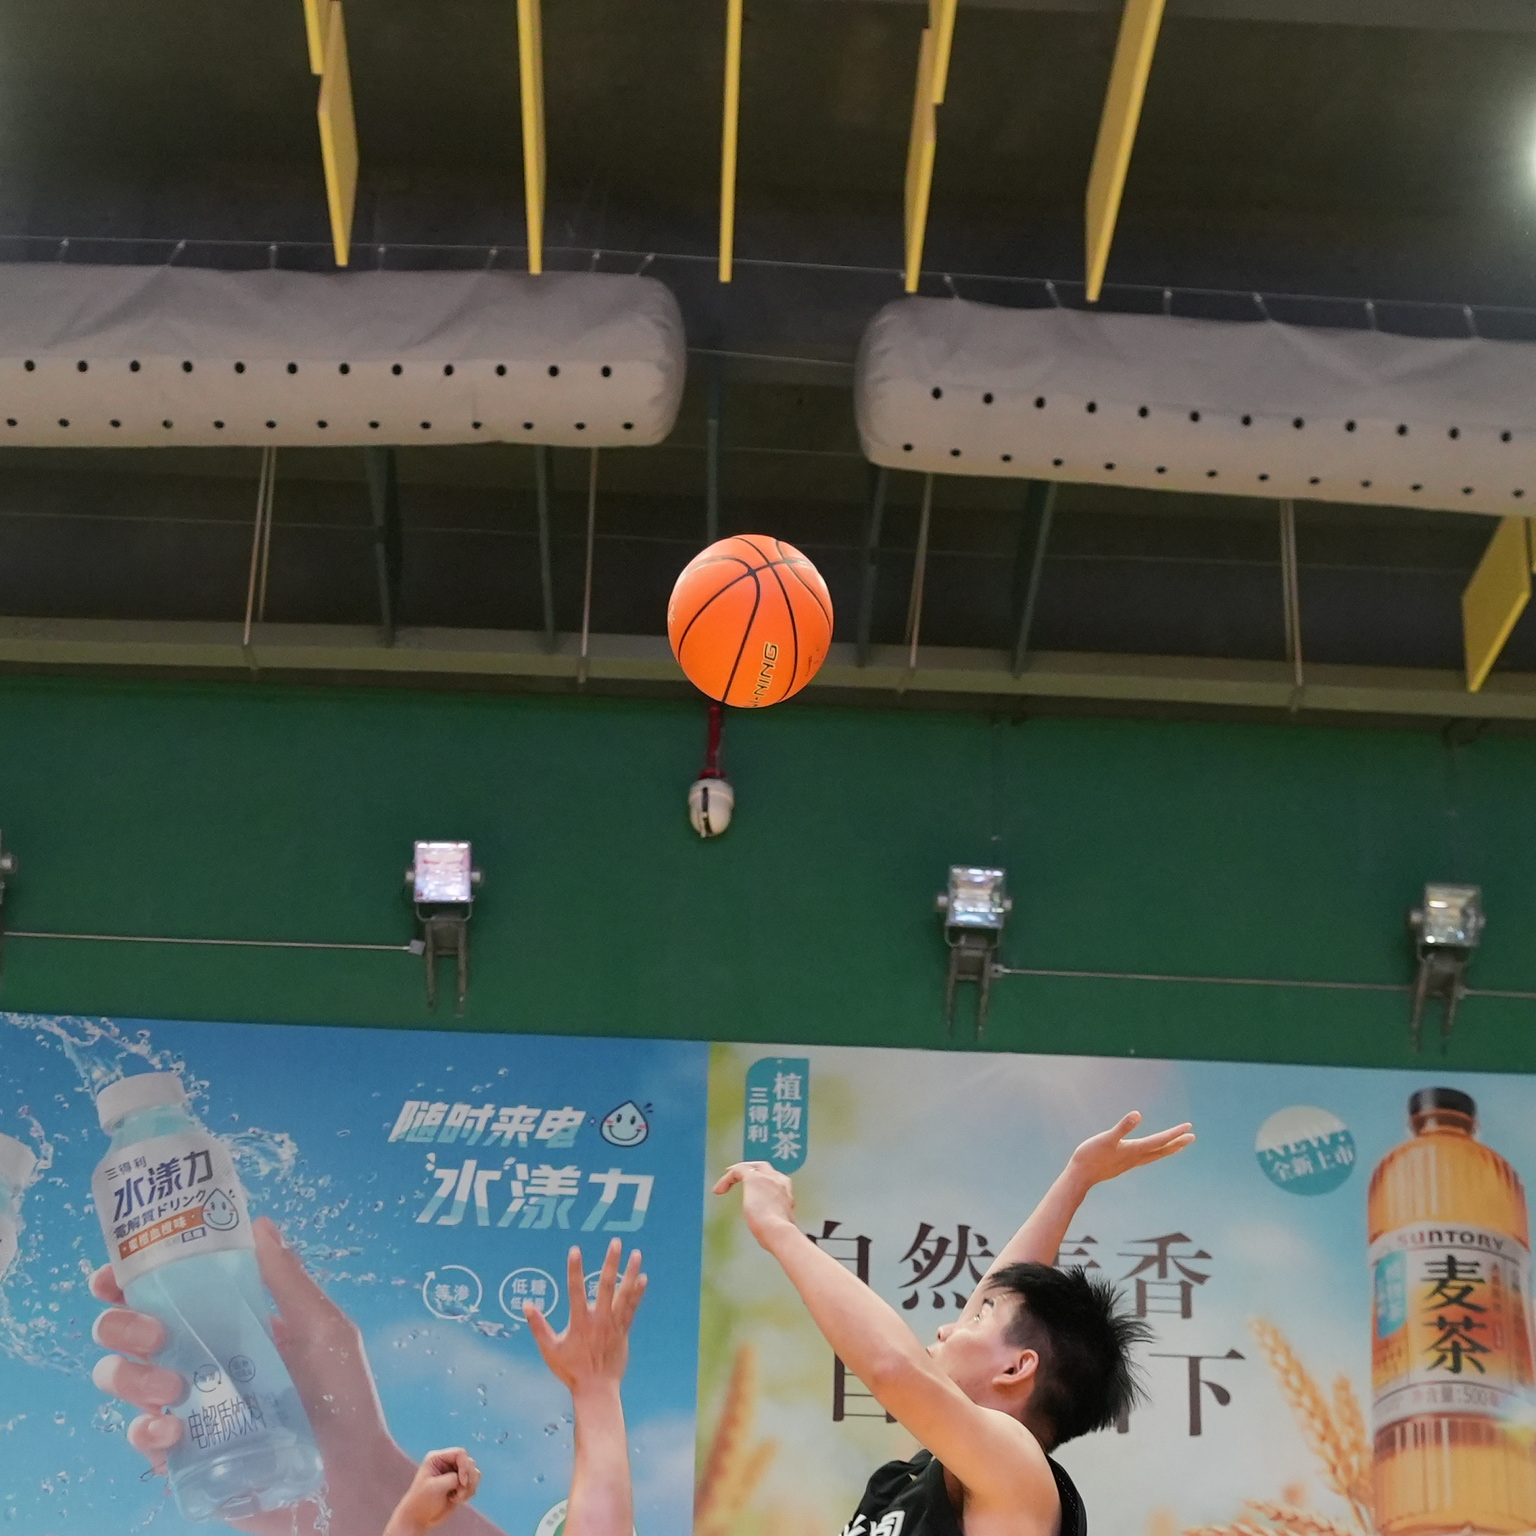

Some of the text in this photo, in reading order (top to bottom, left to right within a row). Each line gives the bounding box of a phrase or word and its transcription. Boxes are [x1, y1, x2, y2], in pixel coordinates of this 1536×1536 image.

[387, 1100, 586, 1148] 随时来电
[747, 1087, 769, 1143] 三得利
[771, 1071, 802, 1160] 植物茶
[105, 1155, 147, 1181] 三得利
[113, 1149, 213, 1223] 水漾力
[416, 1153, 655, 1232] 水漾力
[1420, 1254, 1493, 1374] 麦茶
